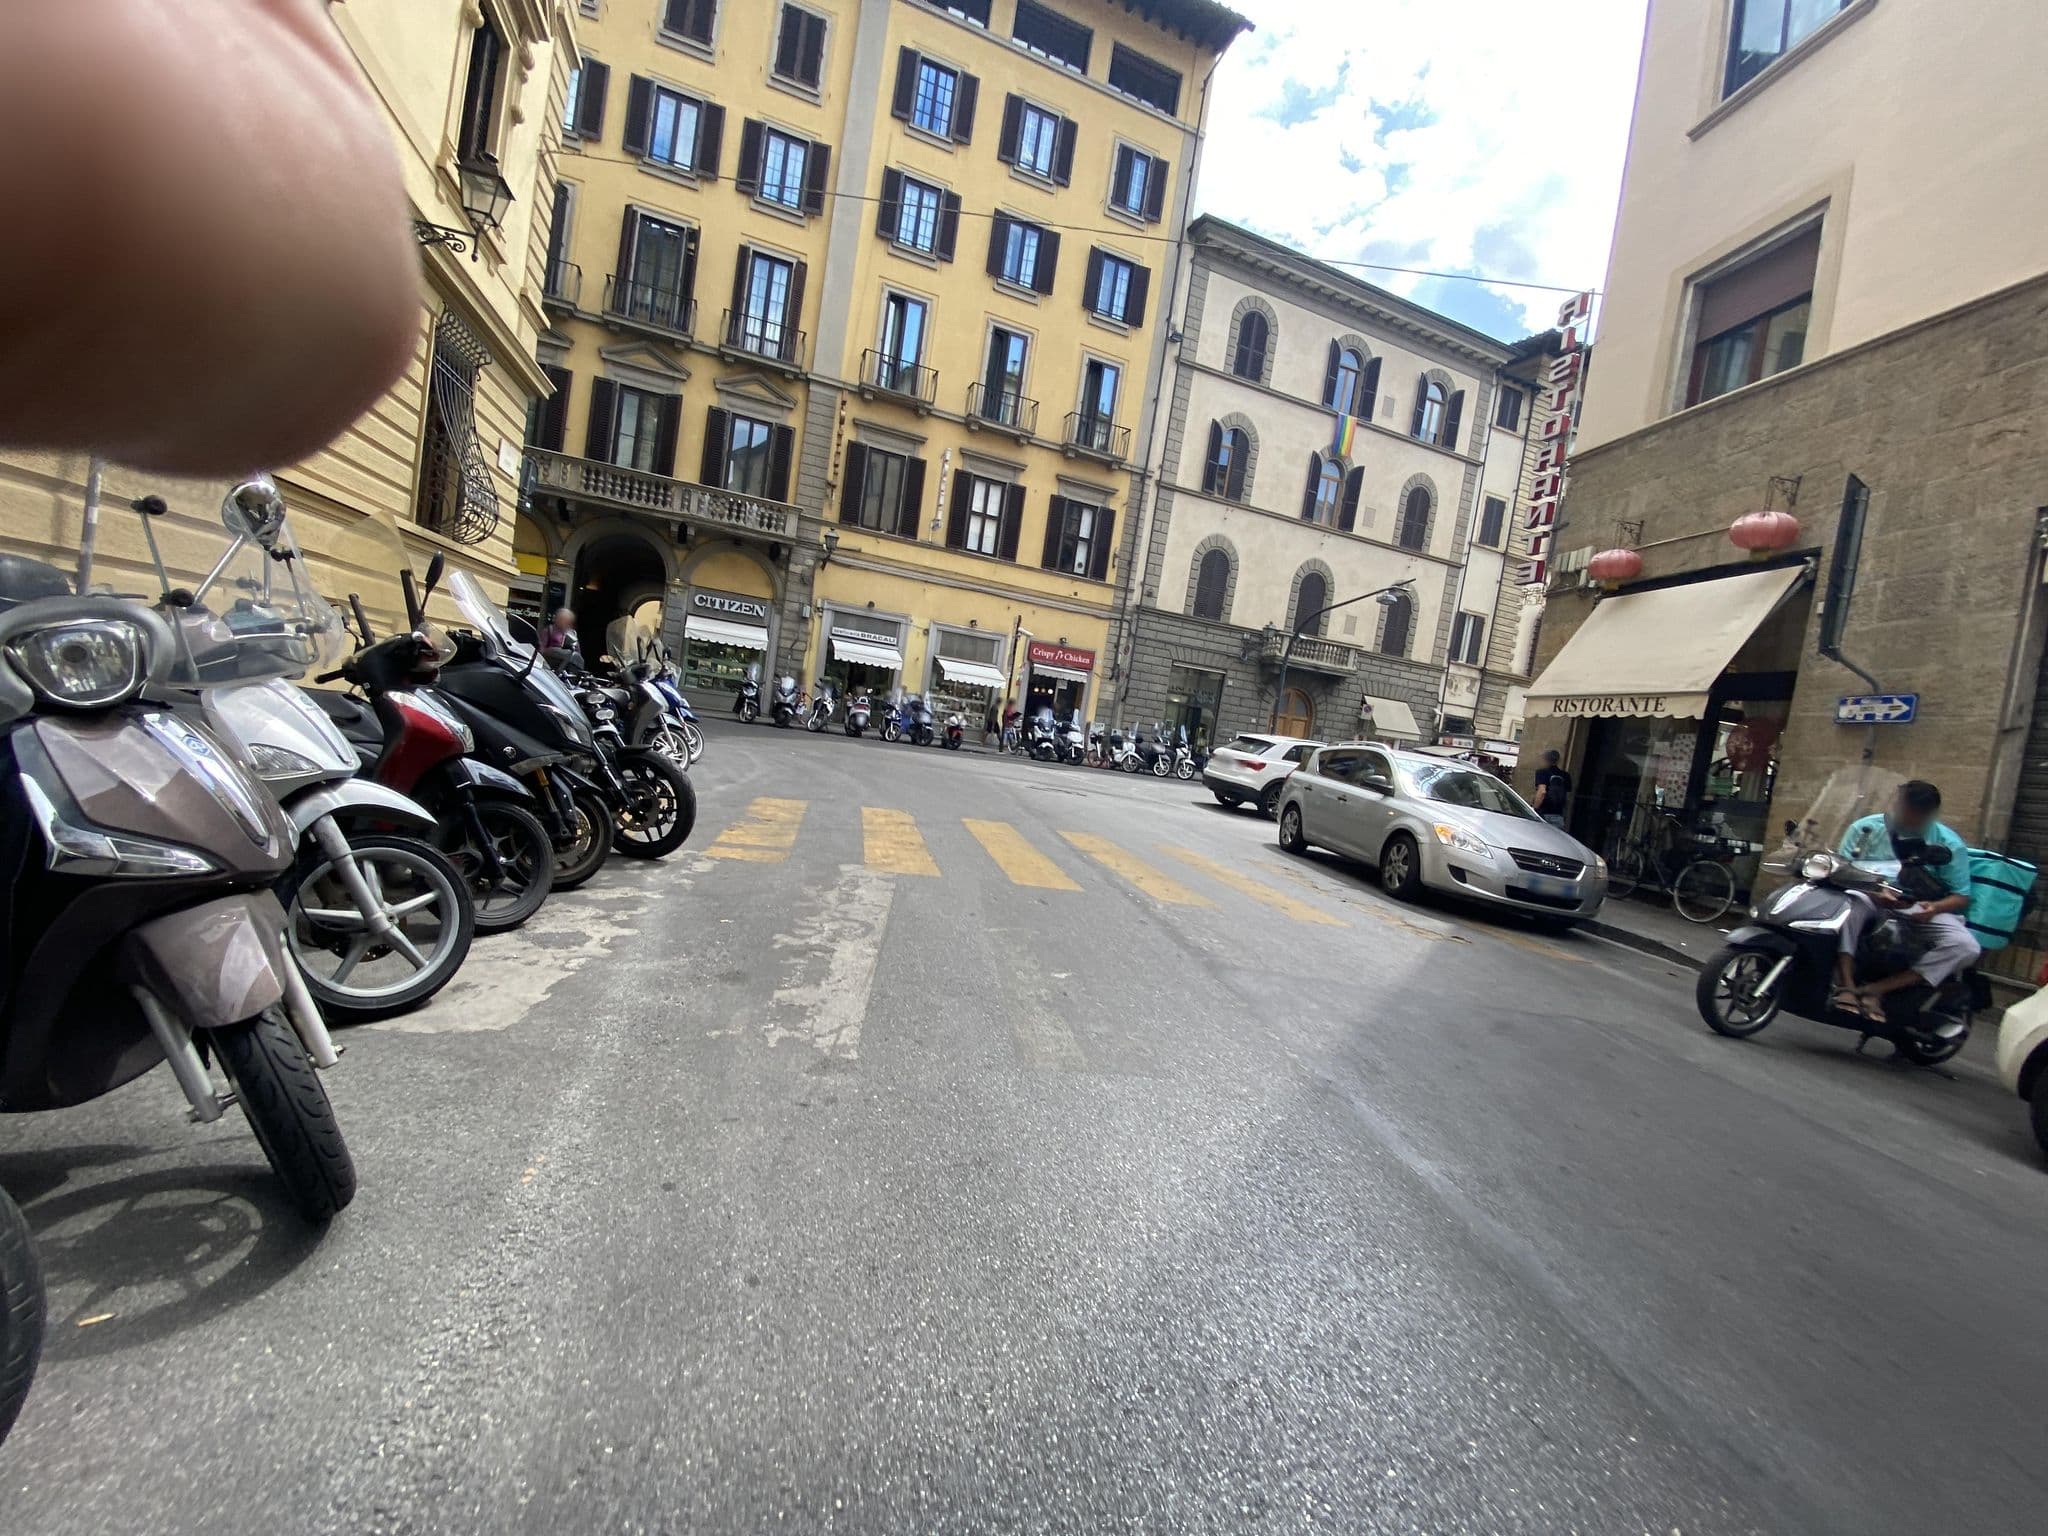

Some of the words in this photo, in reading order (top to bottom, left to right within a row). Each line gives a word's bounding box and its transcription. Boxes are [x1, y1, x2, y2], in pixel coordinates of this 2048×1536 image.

[694, 593, 767, 617] CITIZEN
[1032, 647, 1056, 660] Crispy
[1064, 652, 1090, 664] Chicken
[1552, 696, 1668, 713] RISTORANTE
